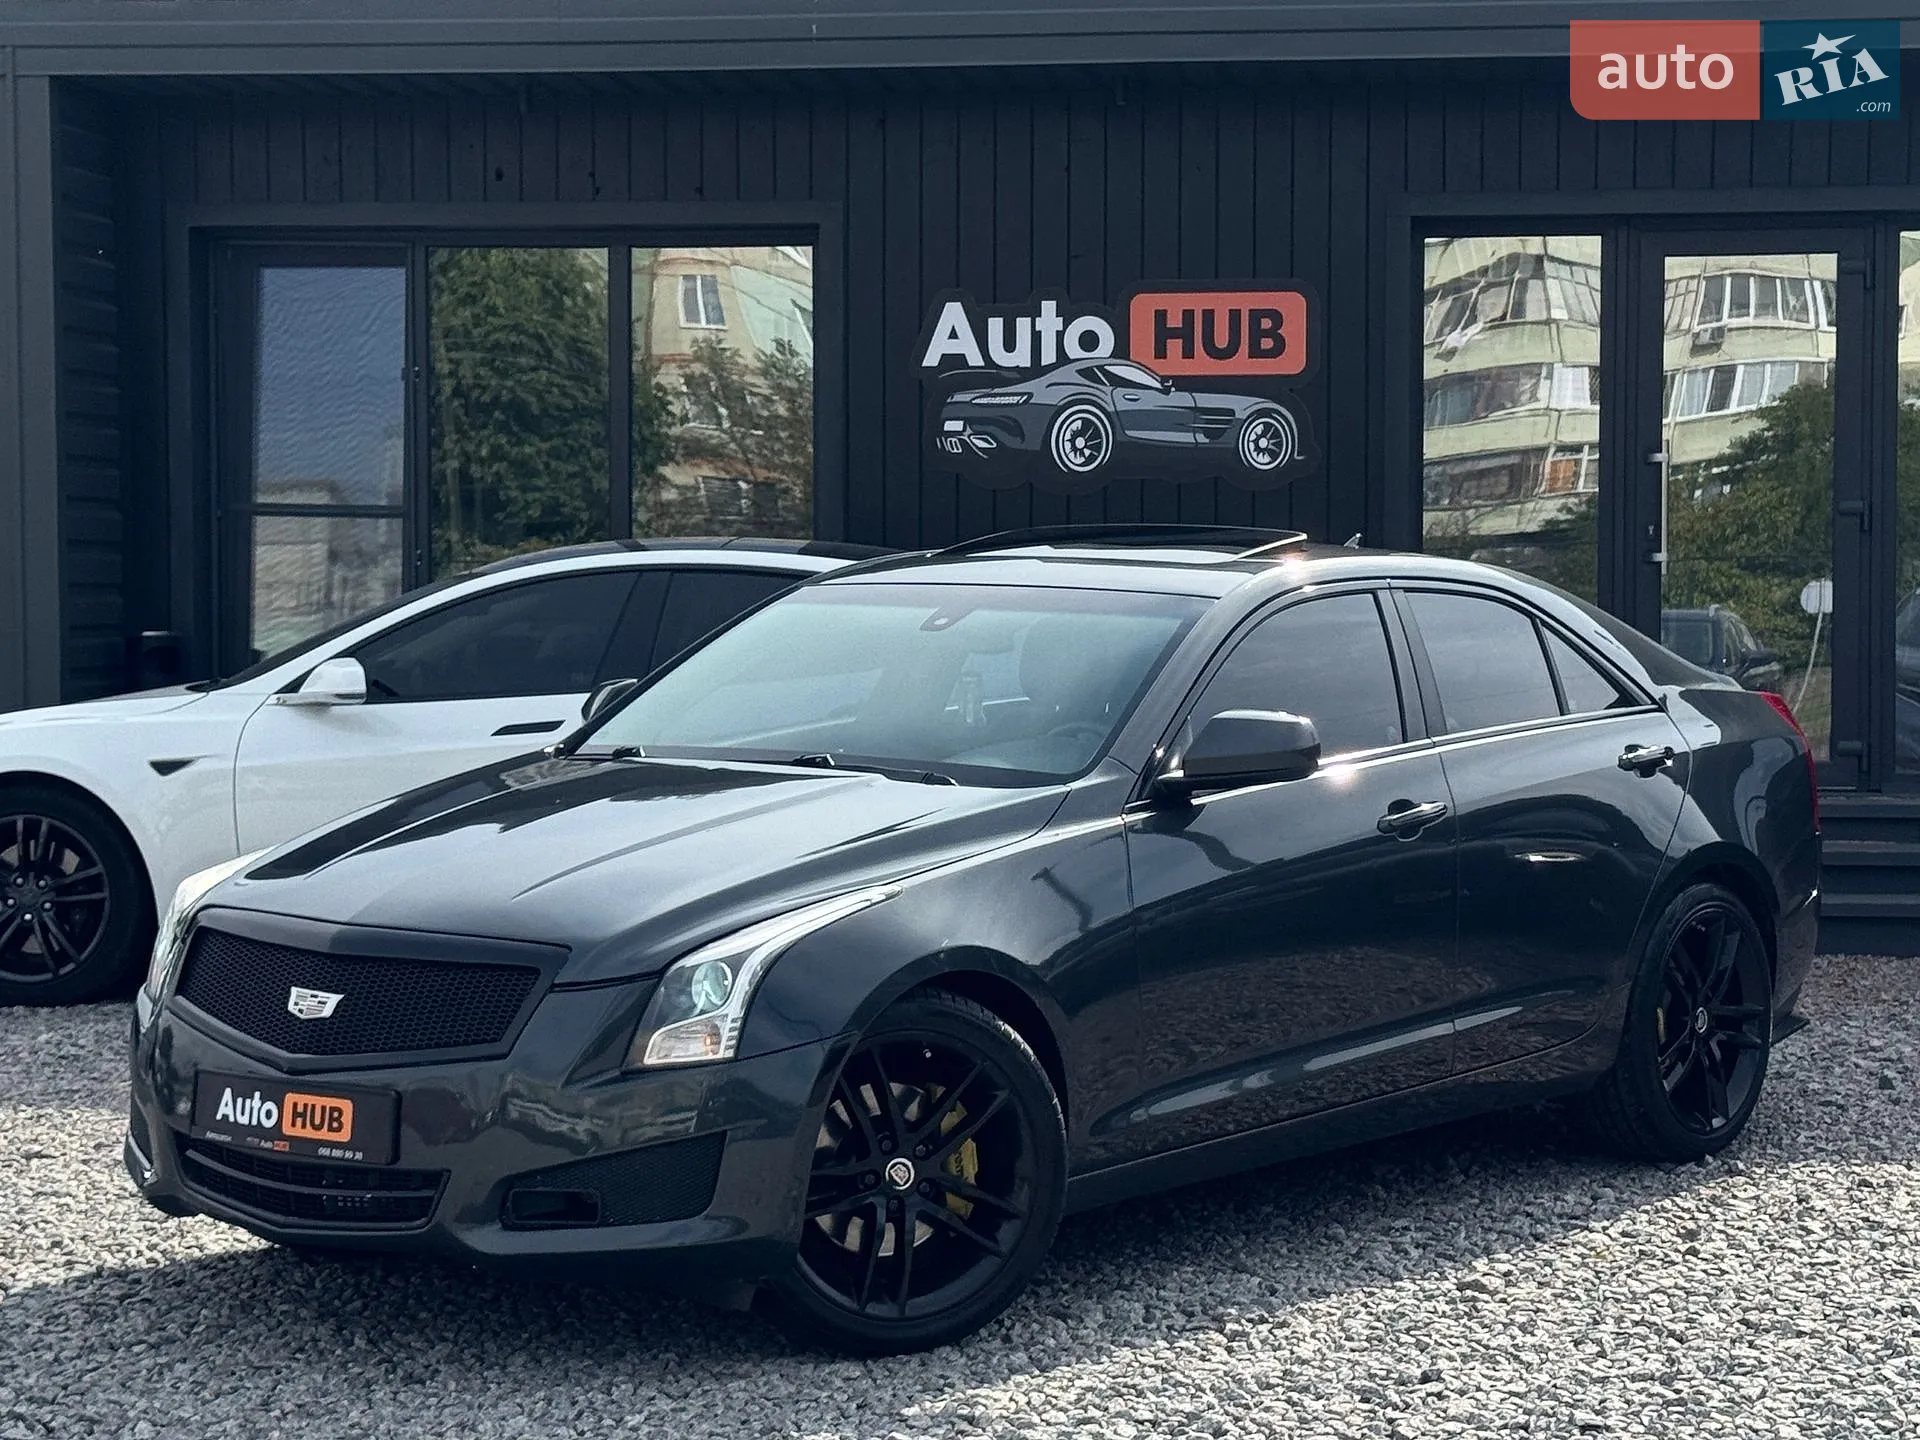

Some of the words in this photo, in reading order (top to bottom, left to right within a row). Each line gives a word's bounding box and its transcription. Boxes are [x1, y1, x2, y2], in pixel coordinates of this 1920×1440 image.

[921, 300, 1115, 368] Auto
[1154, 308, 1286, 361] HUB
[216, 1087, 279, 1129] Auto
[290, 1101, 345, 1133] HUB
